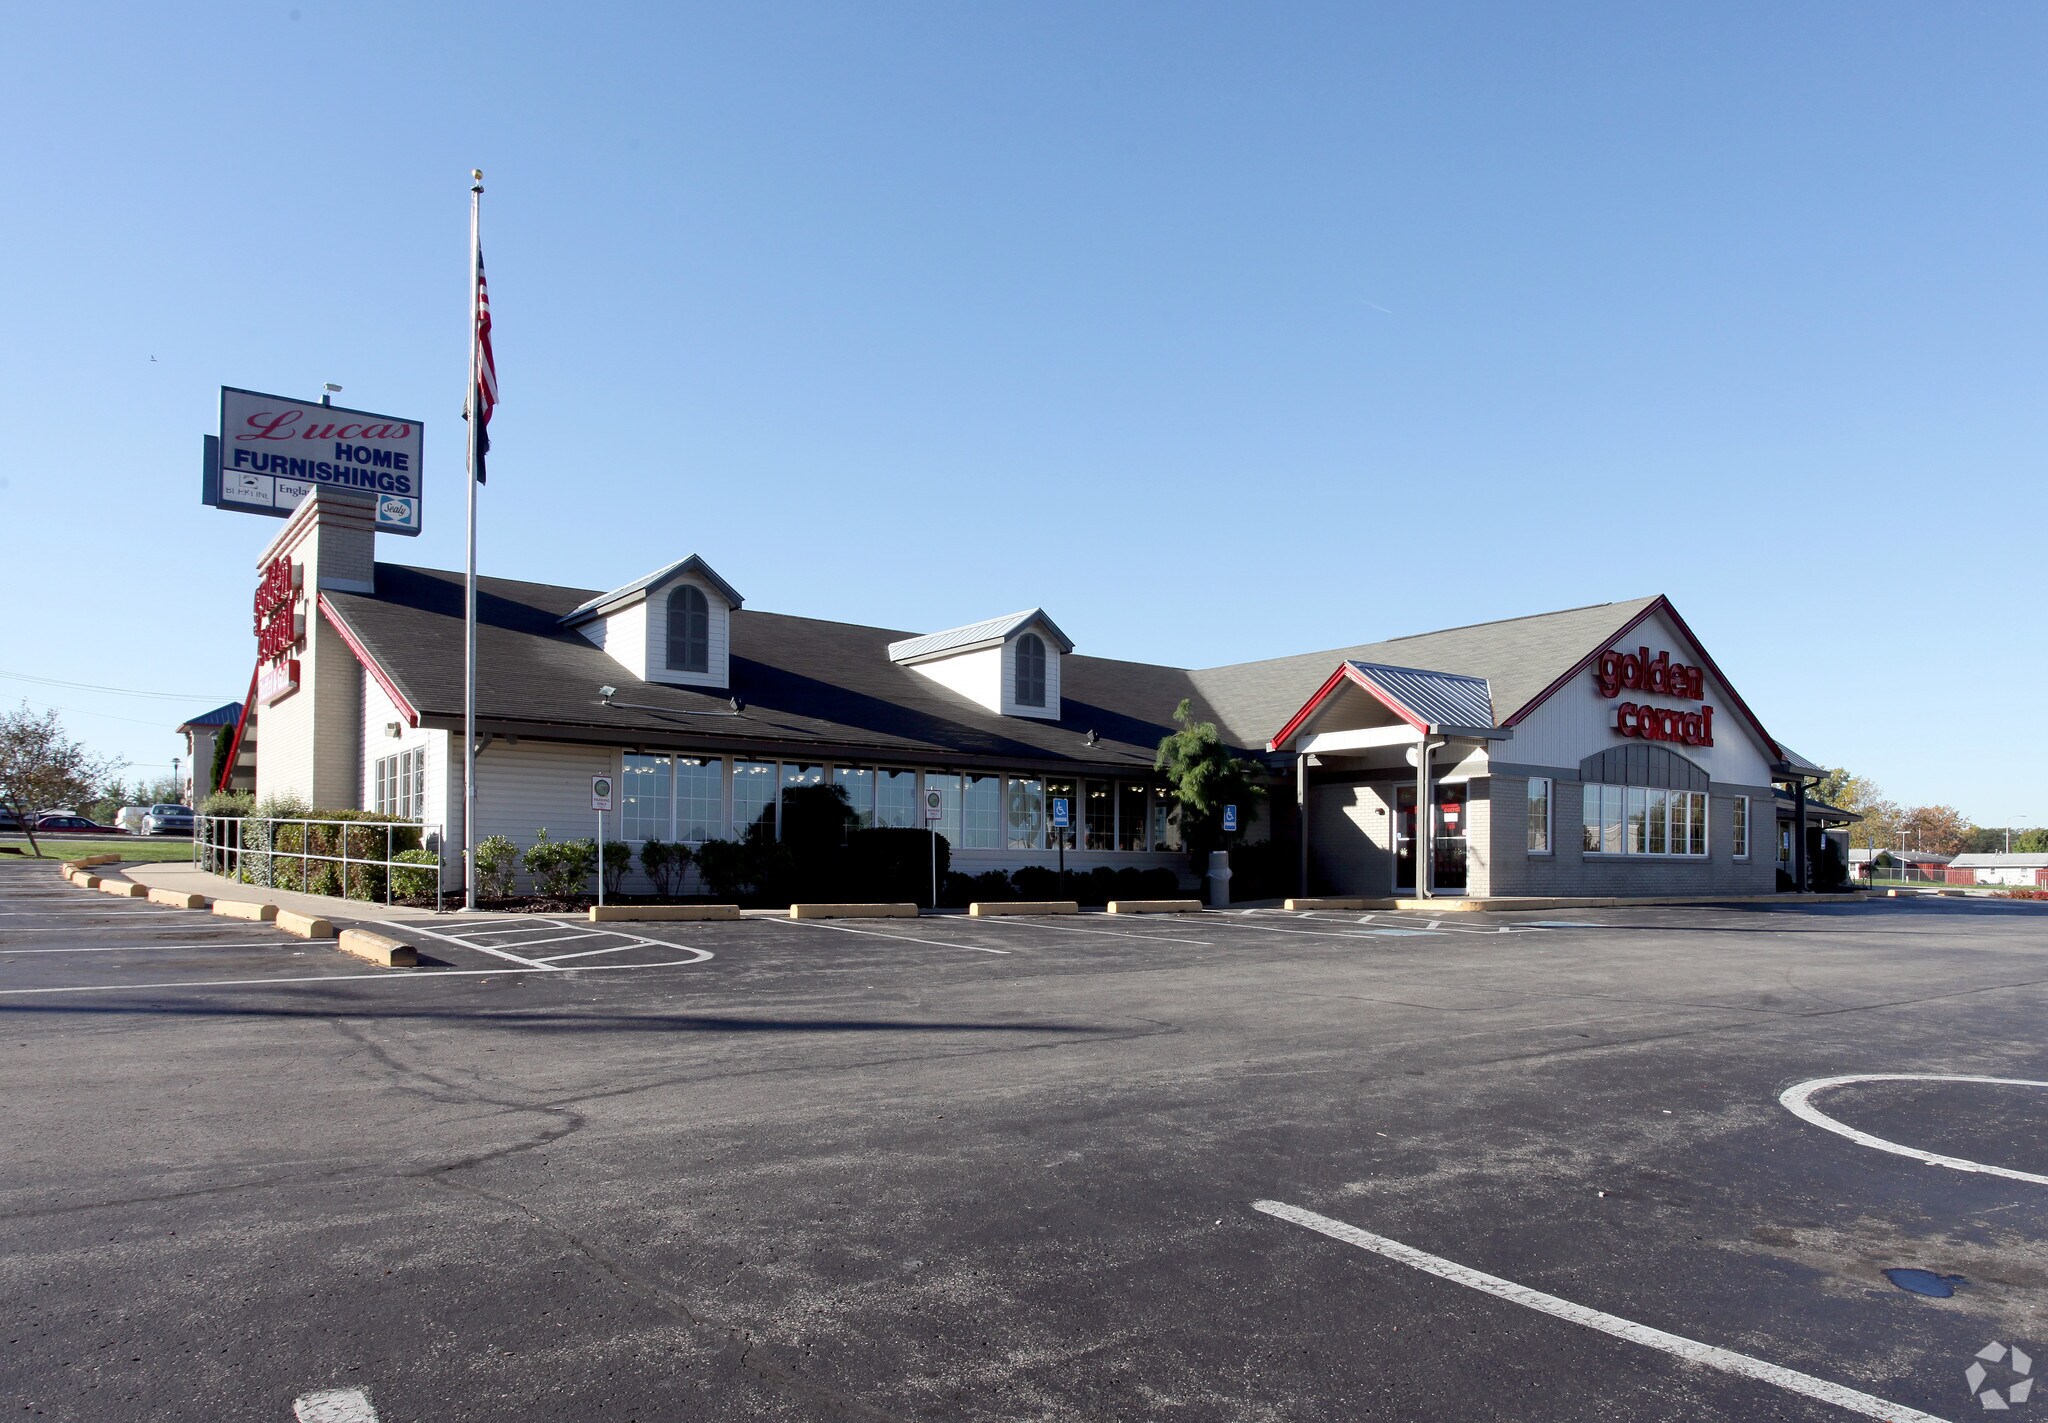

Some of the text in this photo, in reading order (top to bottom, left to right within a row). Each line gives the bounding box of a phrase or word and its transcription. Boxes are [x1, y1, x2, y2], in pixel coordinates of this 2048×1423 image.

[235, 410, 411, 441] Lucas
[234, 448, 411, 494] FURNISHINGS
[335, 442, 409, 472] HOME
[280, 484, 309, 497] Engla
[384, 503, 406, 516] Sealy
[1599, 646, 1704, 701] golden
[1617, 702, 1714, 747] corral
